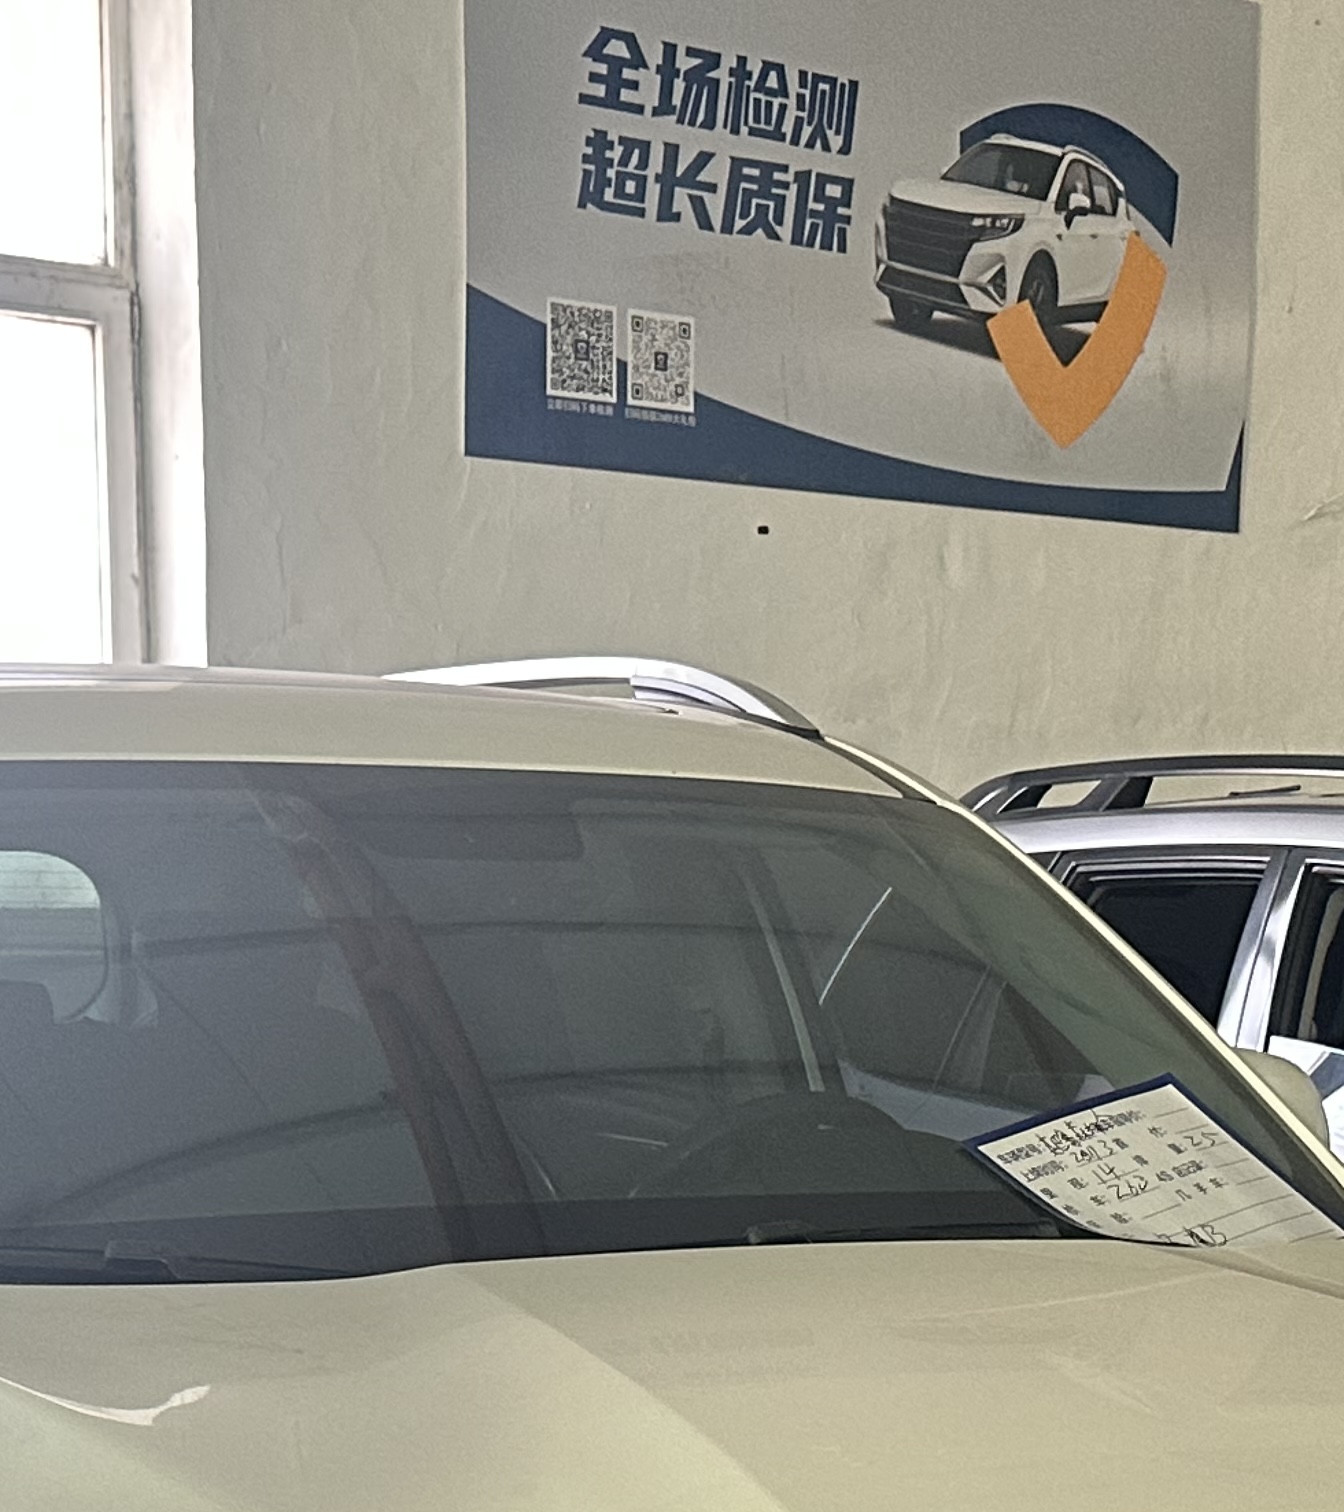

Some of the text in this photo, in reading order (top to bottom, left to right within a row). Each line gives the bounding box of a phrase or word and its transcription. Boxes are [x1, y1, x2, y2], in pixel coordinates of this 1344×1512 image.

[577, 25, 860, 156] 全场检测
[576, 127, 856, 254] 超长质保
